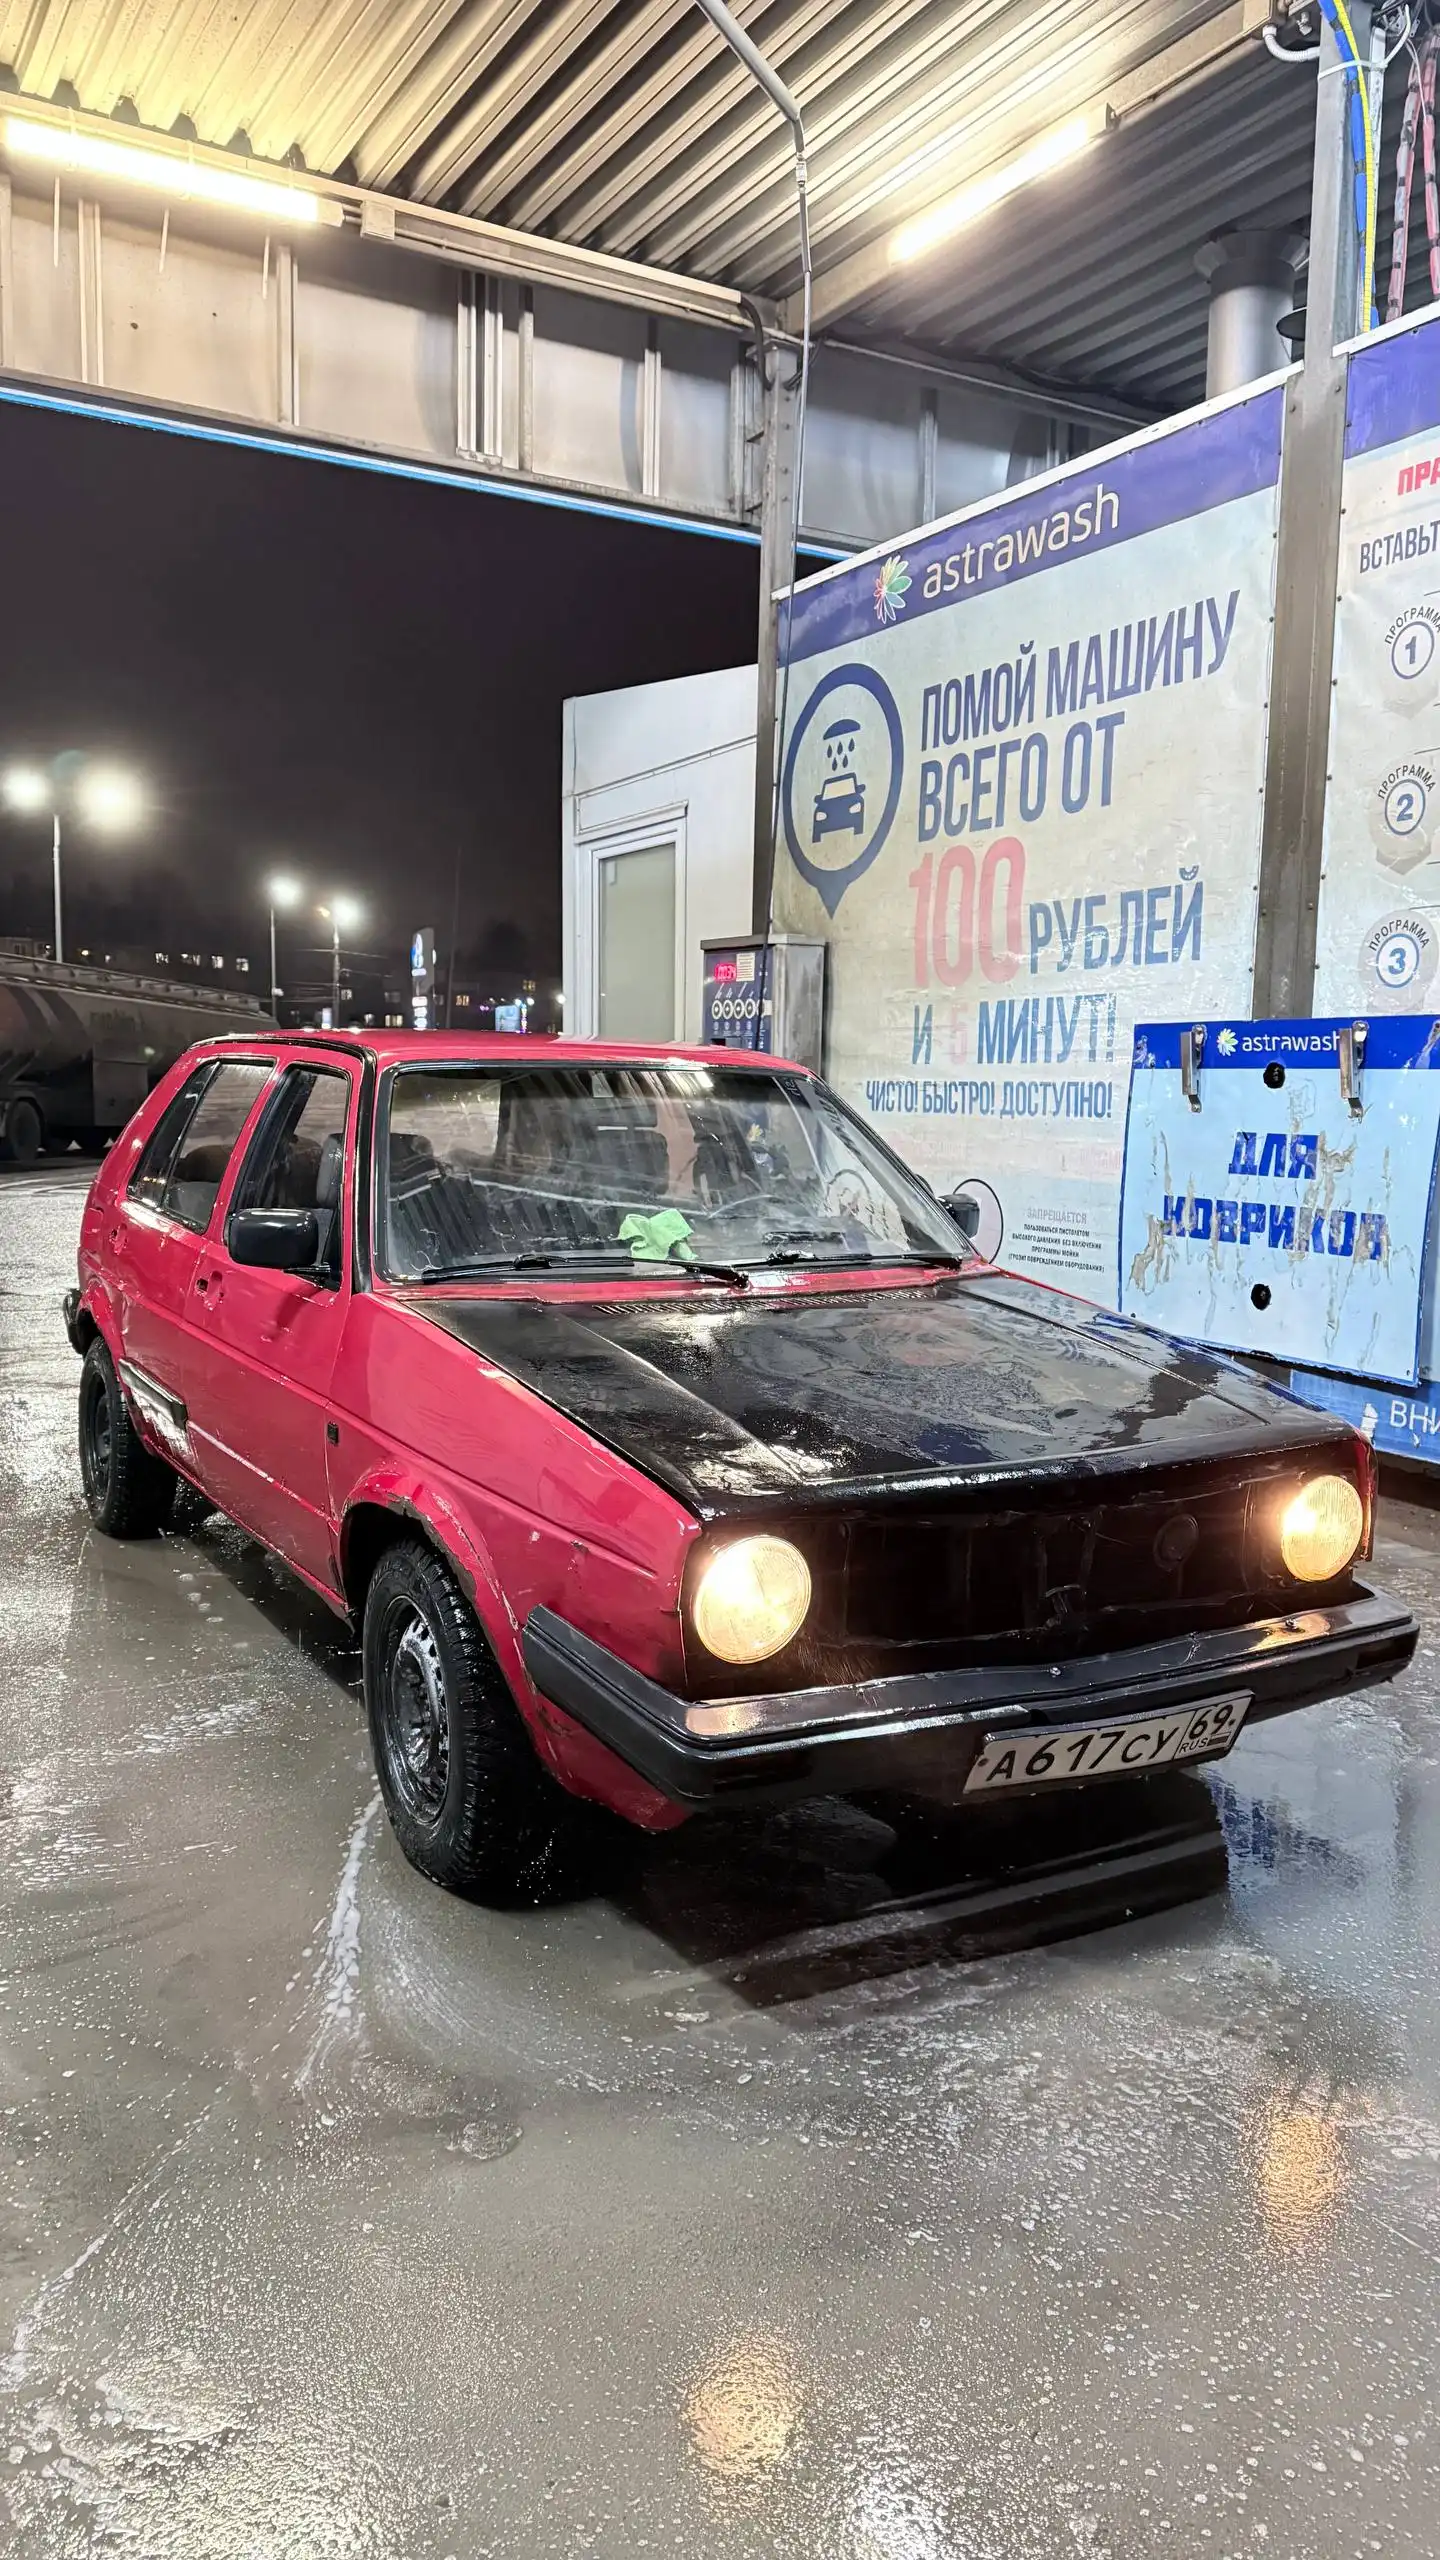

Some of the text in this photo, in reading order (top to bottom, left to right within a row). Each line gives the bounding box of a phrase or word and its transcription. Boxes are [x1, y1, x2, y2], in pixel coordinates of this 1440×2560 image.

[923, 484, 1120, 599] astrawash
[1360, 520, 1440, 573] ВСТАВЬТ
[1405, 636, 1417, 664] 1
[921, 589, 1241, 752] ПОМОЙ МАШИНУ
[918, 711, 1125, 842] ВСЕГО ОТ
[1378, 764, 1436, 799] ПРОГРАММА
[1397, 793, 1414, 822] 2
[909, 836, 1204, 988] 100 РУБЛЕЙ
[1368, 920, 1430, 951] ПРОГРАММА
[1388, 947, 1406, 975] 3
[912, 993, 1117, 1065] И 5 МИНУТ!
[866, 1080, 1112, 1119] ЧИСТО! БЫСТРО! ДОСТУПНО!
[1228, 1132, 1320, 1180] ДЛЯ
[1027, 1208, 1087, 1225] ЗАПРЕЩАЕТСЯ
[1189, 1703, 1234, 1740] 69
[1179, 1737, 1208, 1754] RUS
